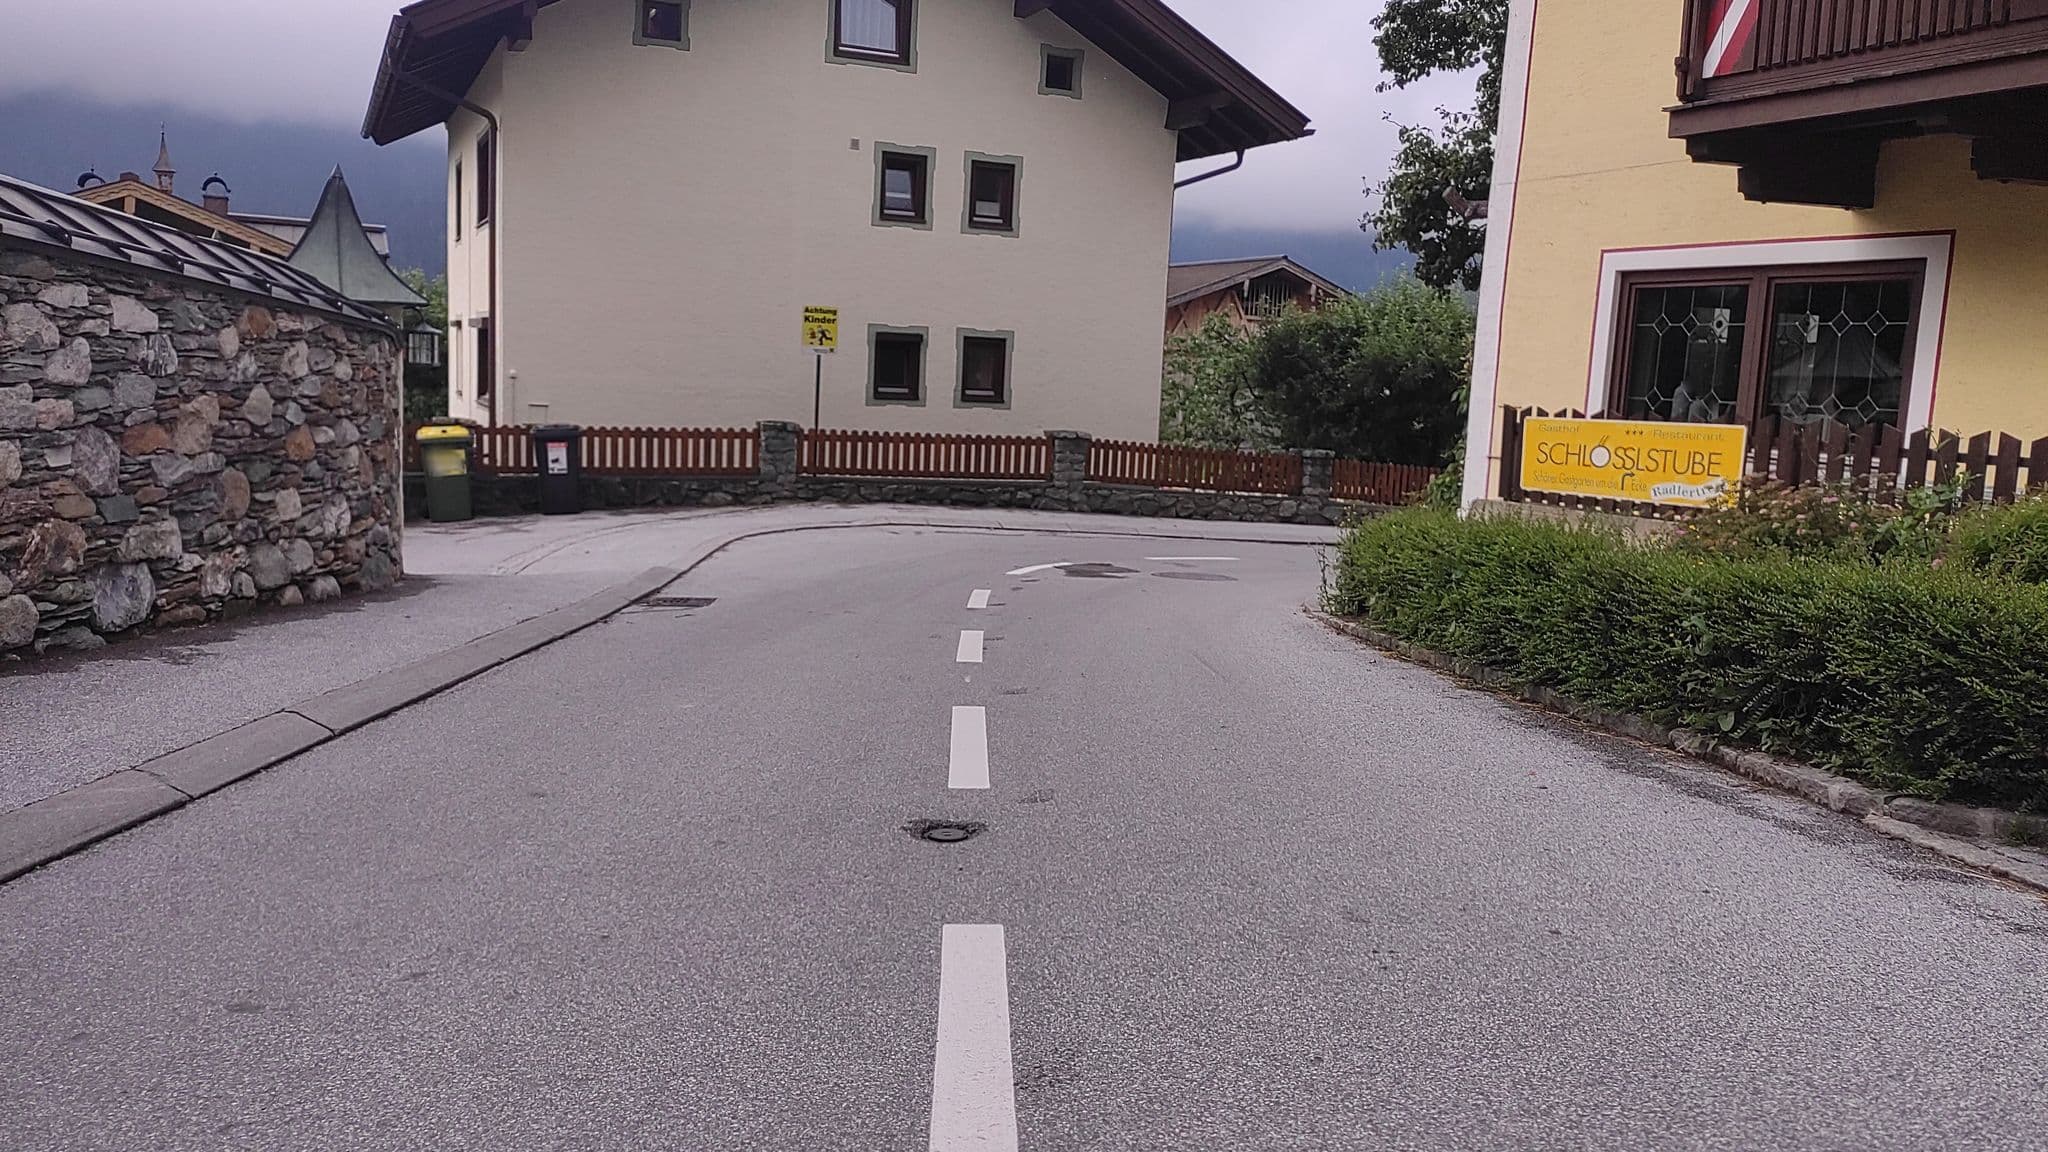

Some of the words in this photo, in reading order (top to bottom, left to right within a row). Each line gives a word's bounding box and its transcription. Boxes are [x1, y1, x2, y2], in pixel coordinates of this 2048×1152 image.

[804, 306, 837, 316] Achtung
[804, 315, 837, 324] Kinder
[1538, 423, 1582, 433] Gasthof
[1652, 429, 1725, 441] Restaurant
[1536, 435, 1722, 477] SCHLÖSSLSTUBE
[1631, 481, 1647, 492] Ecke
